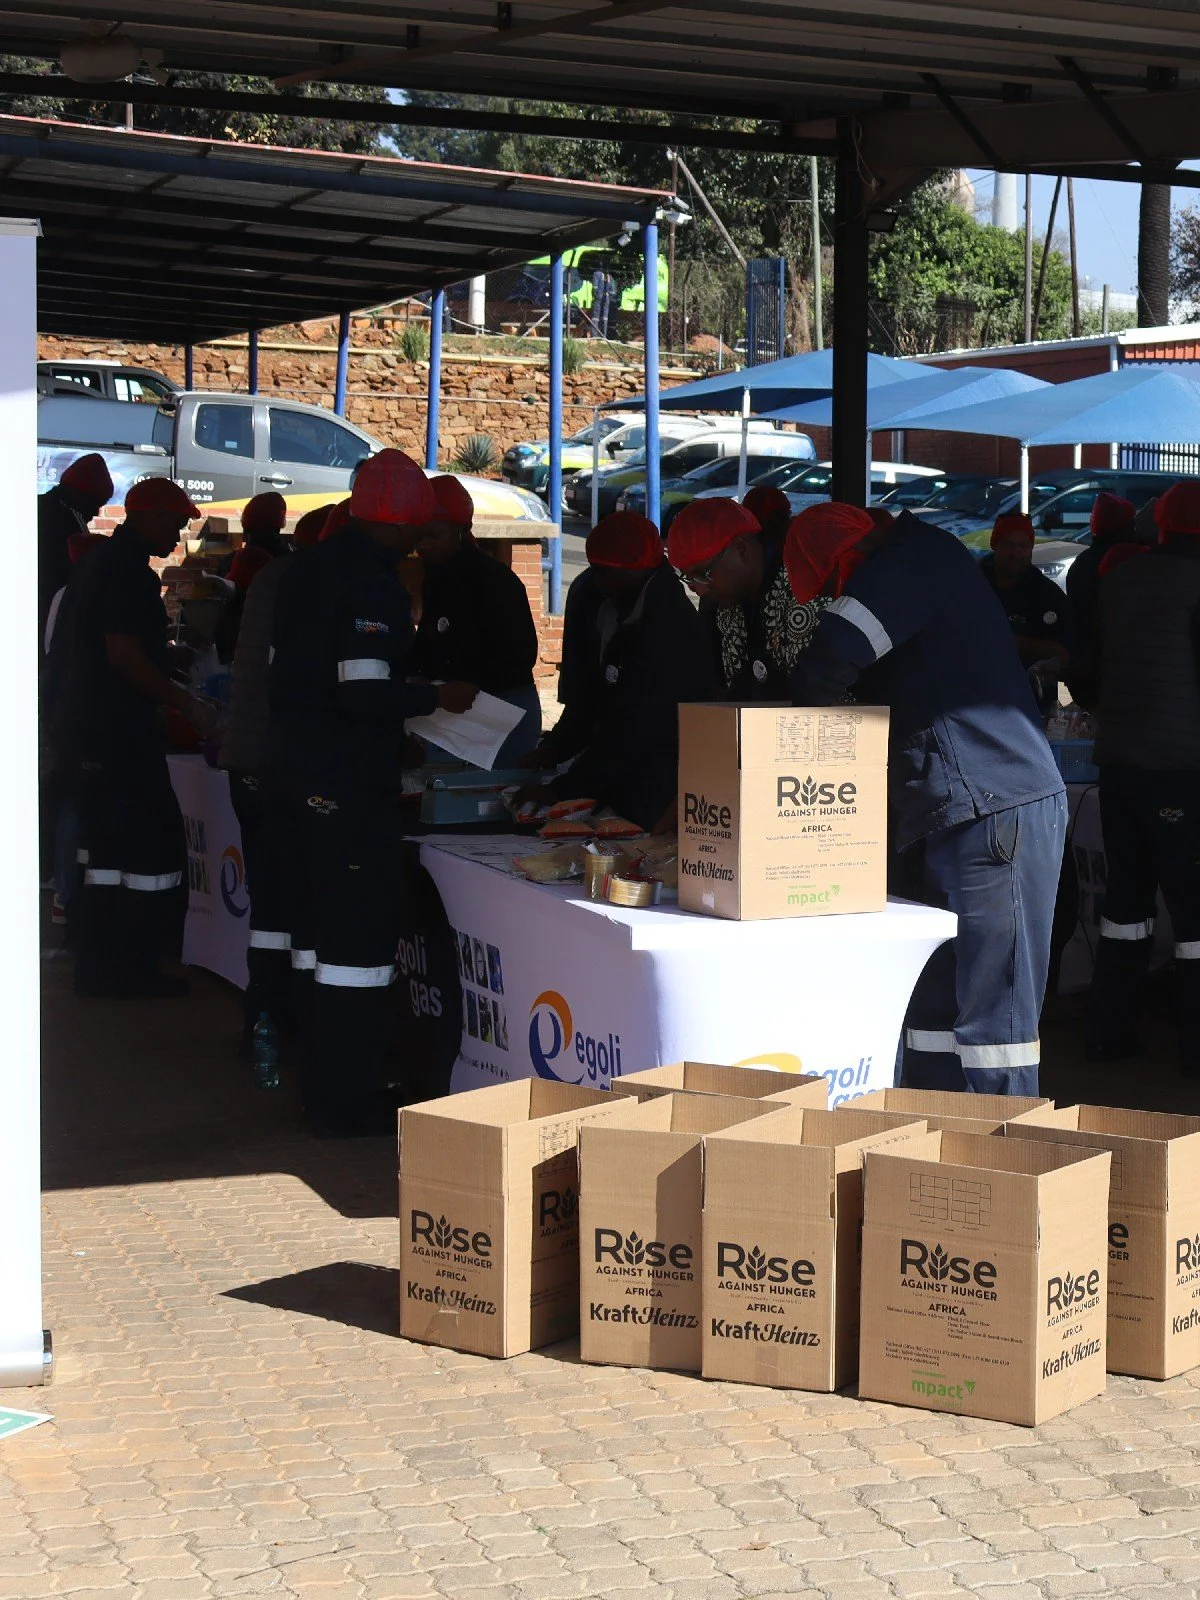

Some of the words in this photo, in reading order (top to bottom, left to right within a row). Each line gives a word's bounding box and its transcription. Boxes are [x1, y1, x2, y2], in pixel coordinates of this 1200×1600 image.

[187, 479, 214, 491] 5000
[777, 808, 817, 818] AGAINST
[819, 806, 857, 816] HUNGER
[684, 825, 708, 836] AGAINST
[708, 828, 732, 840] HUNGER
[801, 824, 833, 833] AFRICA
[697, 844, 717, 854] AFRICA
[787, 890, 831, 906] mpact
[409, 978, 443, 1017] gas
[575, 1031, 621, 1081] egoli
[412, 1246, 451, 1260] AGAINST
[453, 1253, 492, 1269] HUNGER
[435, 1269, 467, 1282] AFRICA
[595, 1265, 643, 1277] AGAINST
[647, 1269, 694, 1281] HUNGER
[624, 1287, 663, 1298] AFRICA
[718, 1280, 766, 1293] AGAINST
[769, 1285, 816, 1298] HUNGER
[901, 1278, 948, 1294] AGAINST
[951, 1286, 998, 1301] HUNGER
[746, 1303, 785, 1314] AFRICA
[928, 1303, 967, 1317] AFRICA
[1046, 1308, 1074, 1329] AGAINST
[1074, 1296, 1100, 1315] HUNGER
[1062, 1325, 1083, 1340] AFRICA
[911, 1379, 963, 1400] mpact
